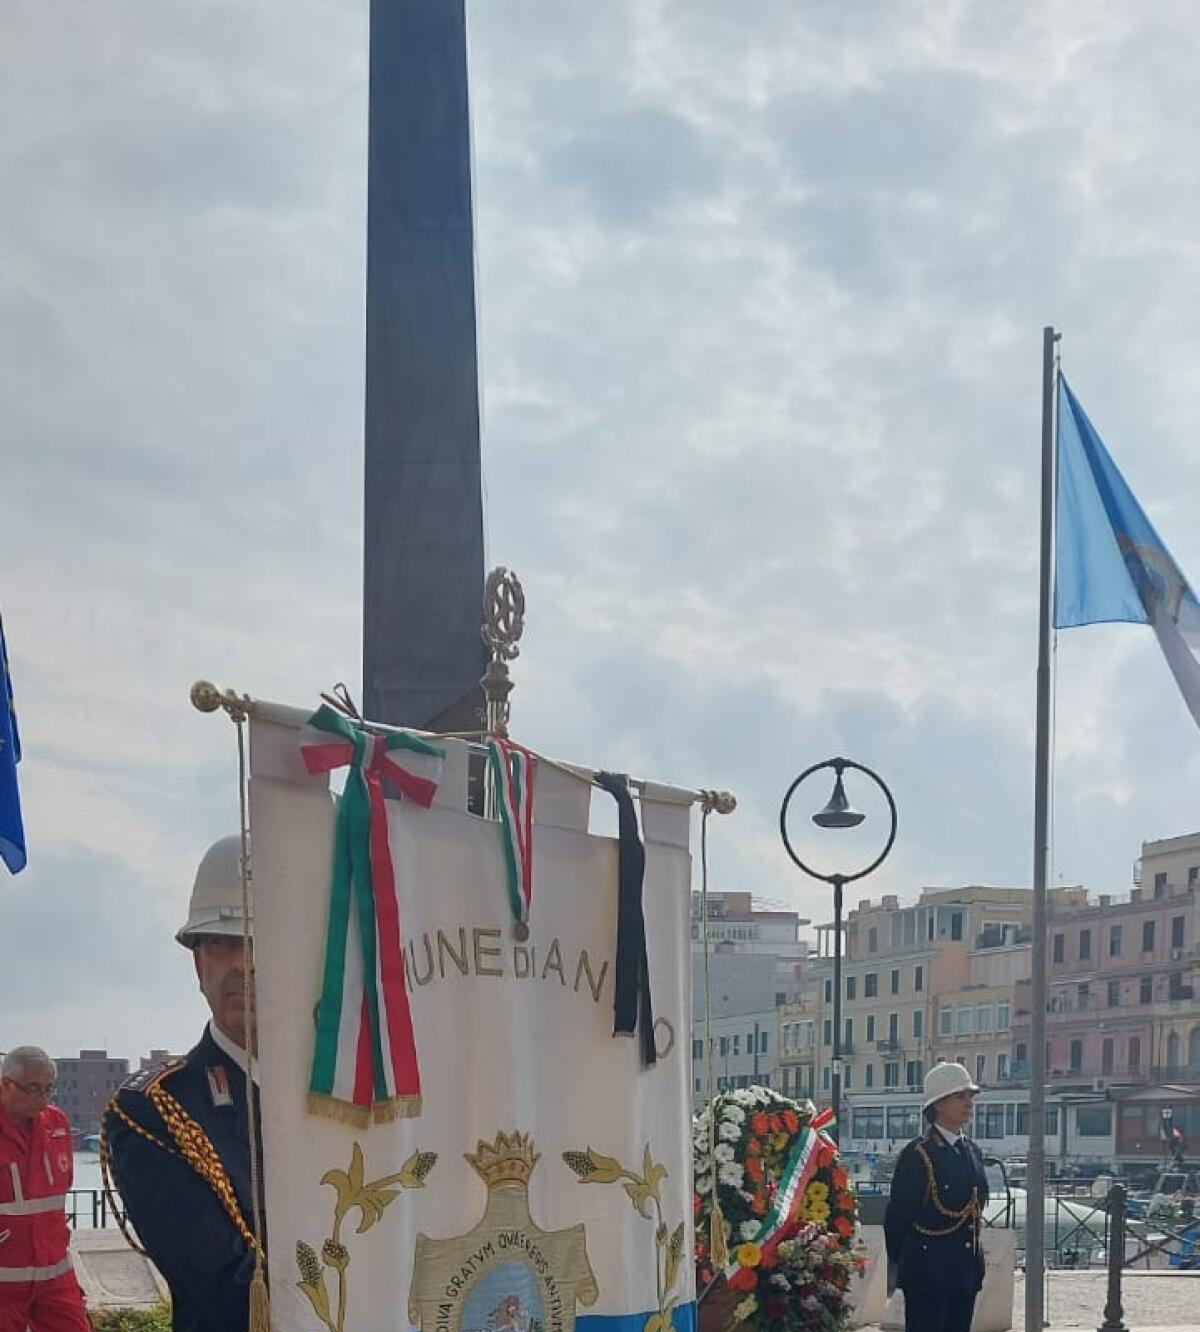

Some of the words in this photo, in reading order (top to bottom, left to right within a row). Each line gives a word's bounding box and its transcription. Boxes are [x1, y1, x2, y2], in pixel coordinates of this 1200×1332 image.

[513, 946, 536, 978] DI
[541, 938, 675, 1060] ANO
[445, 1241, 496, 1298] GRATVM
